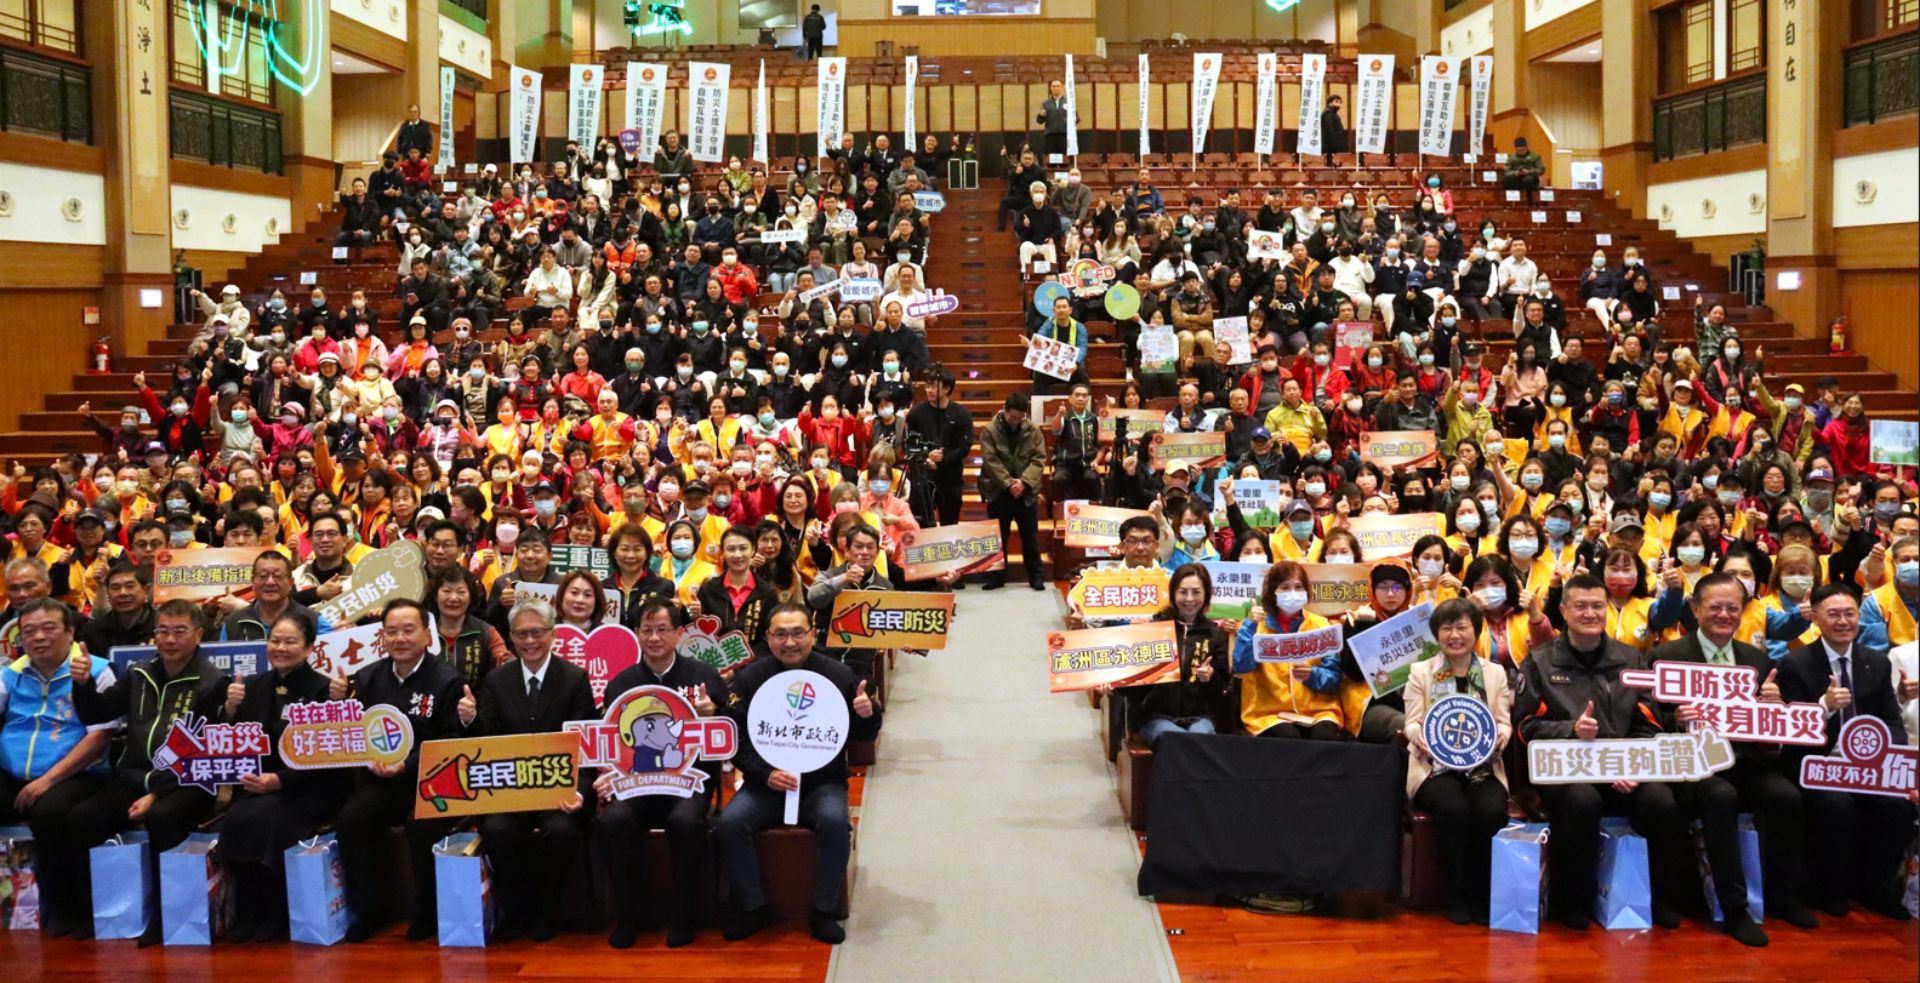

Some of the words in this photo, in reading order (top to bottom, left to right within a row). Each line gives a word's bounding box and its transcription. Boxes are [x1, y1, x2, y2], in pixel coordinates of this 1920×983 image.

[915, 198, 942, 208] 能城市
[551, 547, 610, 568] 三重區
[906, 536, 1000, 565] 三重區大有里
[1217, 572, 1252, 584] 永樂里
[319, 570, 399, 625] 全民防災
[1084, 585, 1158, 608] 全民防災
[868, 609, 947, 633] 全民防災
[1259, 630, 1340, 660] 全民防災
[1379, 624, 1415, 649] 永德里
[1052, 641, 1175, 673] 蘆洲區永德里
[1379, 636, 1426, 666] 防災社區
[1622, 667, 1756, 701] 一日防災
[288, 700, 363, 726] 住在新北
[1691, 703, 1825, 740] 終身防災
[206, 723, 264, 754] 防災
[291, 728, 367, 756] 好幸福
[757, 719, 840, 745] 新北市政府
[190, 757, 259, 783] 保平安
[468, 754, 574, 789] 全民防災
[1534, 738, 1697, 779] 防災有夠讚
[1807, 753, 1917, 788] 防災不分你
[618, 777, 635, 790] FIRE
[638, 775, 693, 789] DEPARTMENT
